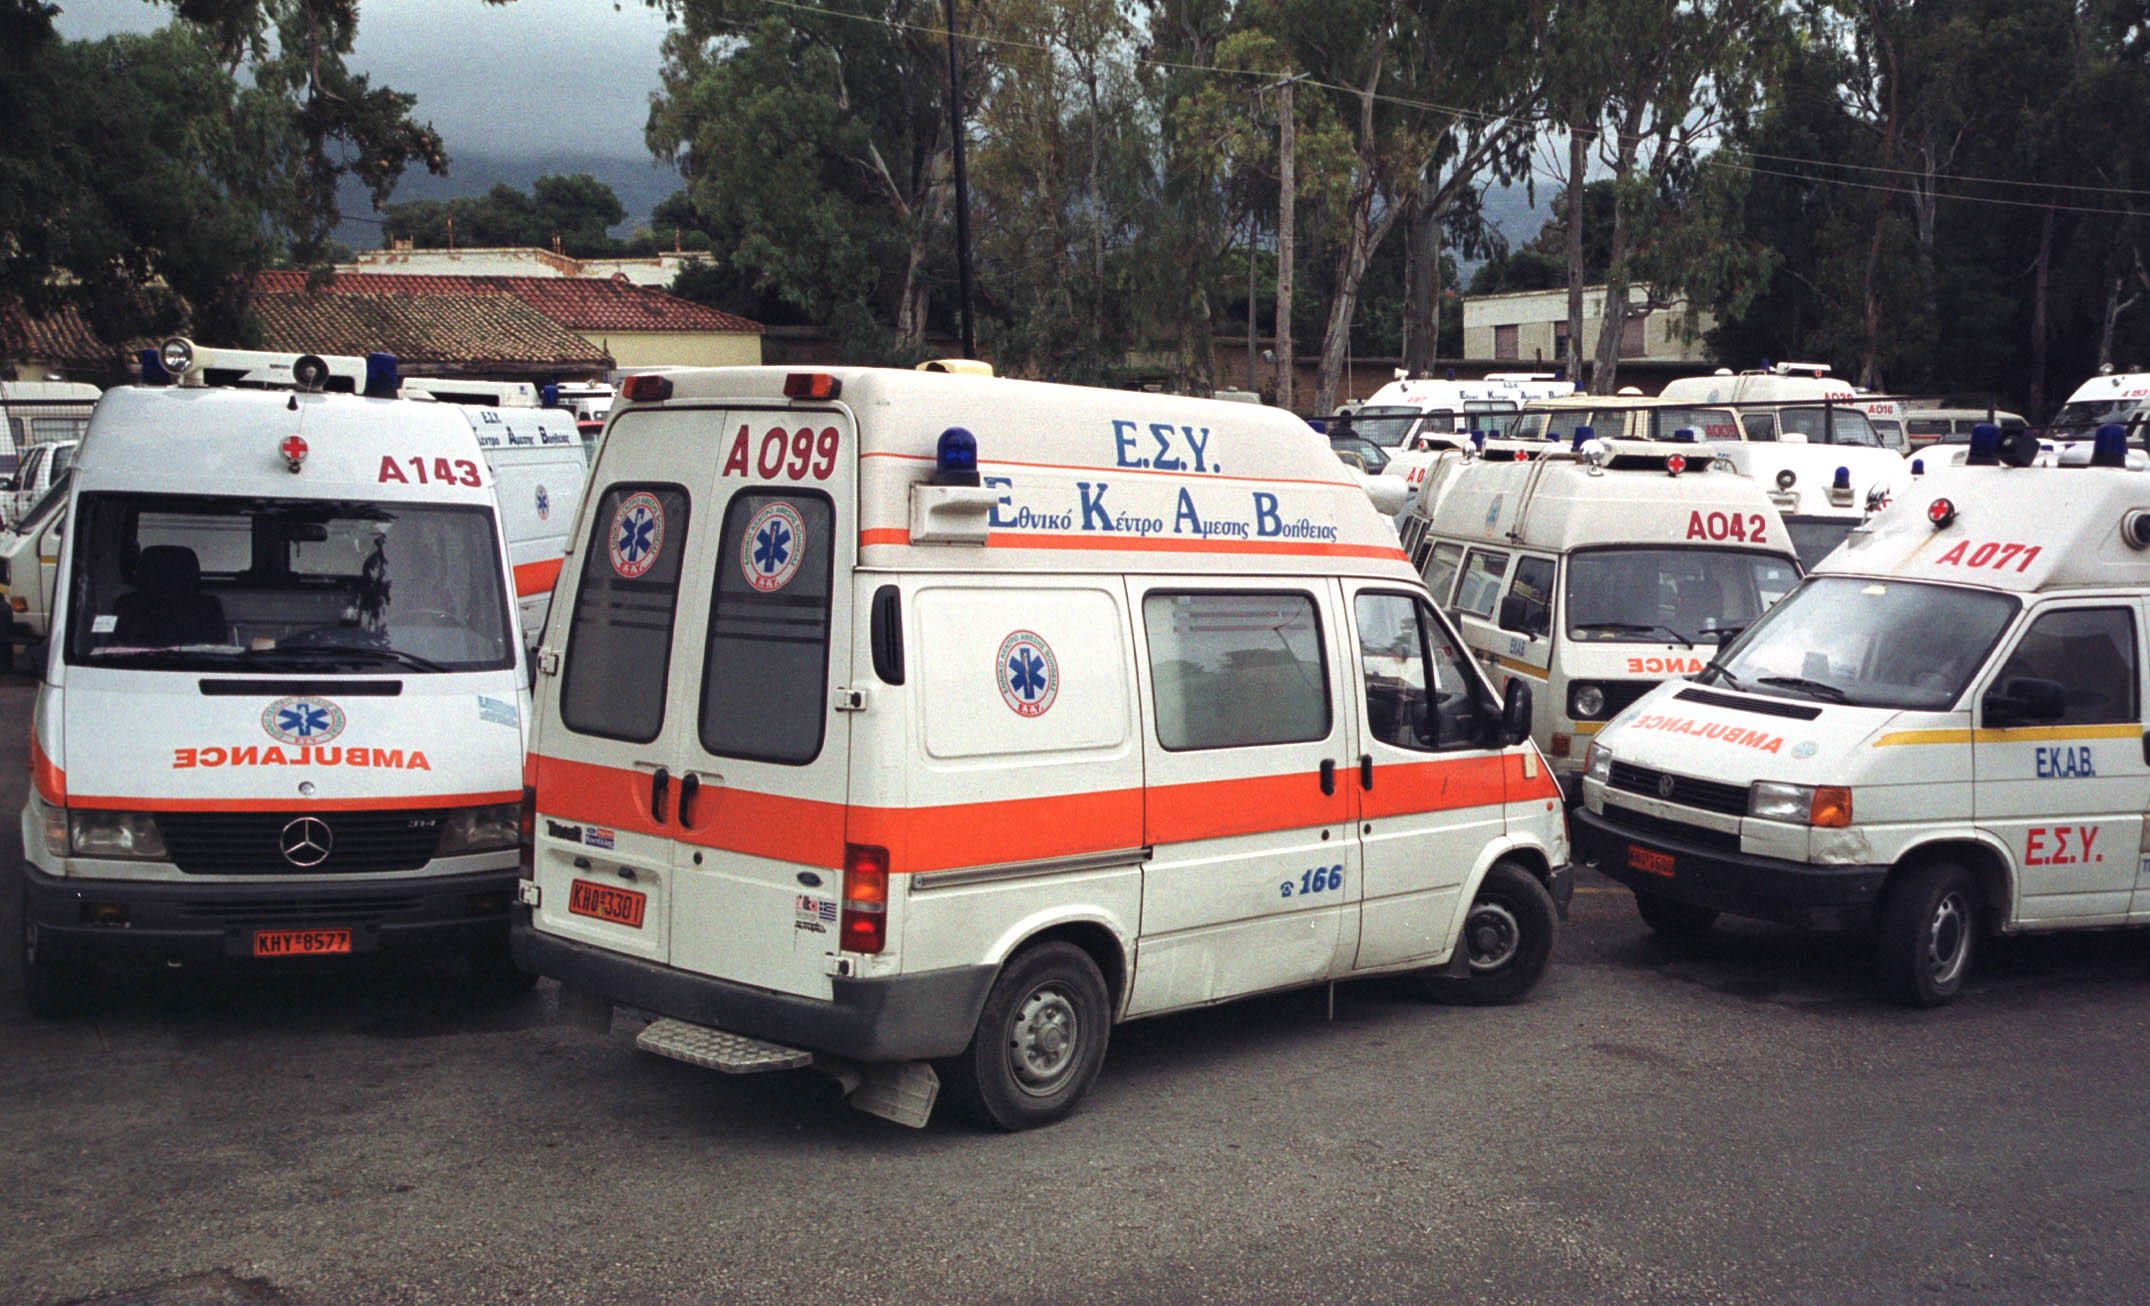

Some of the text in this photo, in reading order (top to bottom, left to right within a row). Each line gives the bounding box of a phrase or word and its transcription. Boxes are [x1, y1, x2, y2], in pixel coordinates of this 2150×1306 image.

[722, 424, 840, 480] A099
[1112, 420, 1221, 473] Ε.Σ.Υ.
[378, 456, 482, 488] A143
[983, 476, 1338, 542] Εθνικό Κέντρο Αμεσης Βοήθειας
[1686, 510, 1767, 543] A042
[1936, 540, 2043, 573] A071
[2025, 825, 2103, 866] Ε.Σ.Υ.
[1299, 864, 1344, 895] 166
